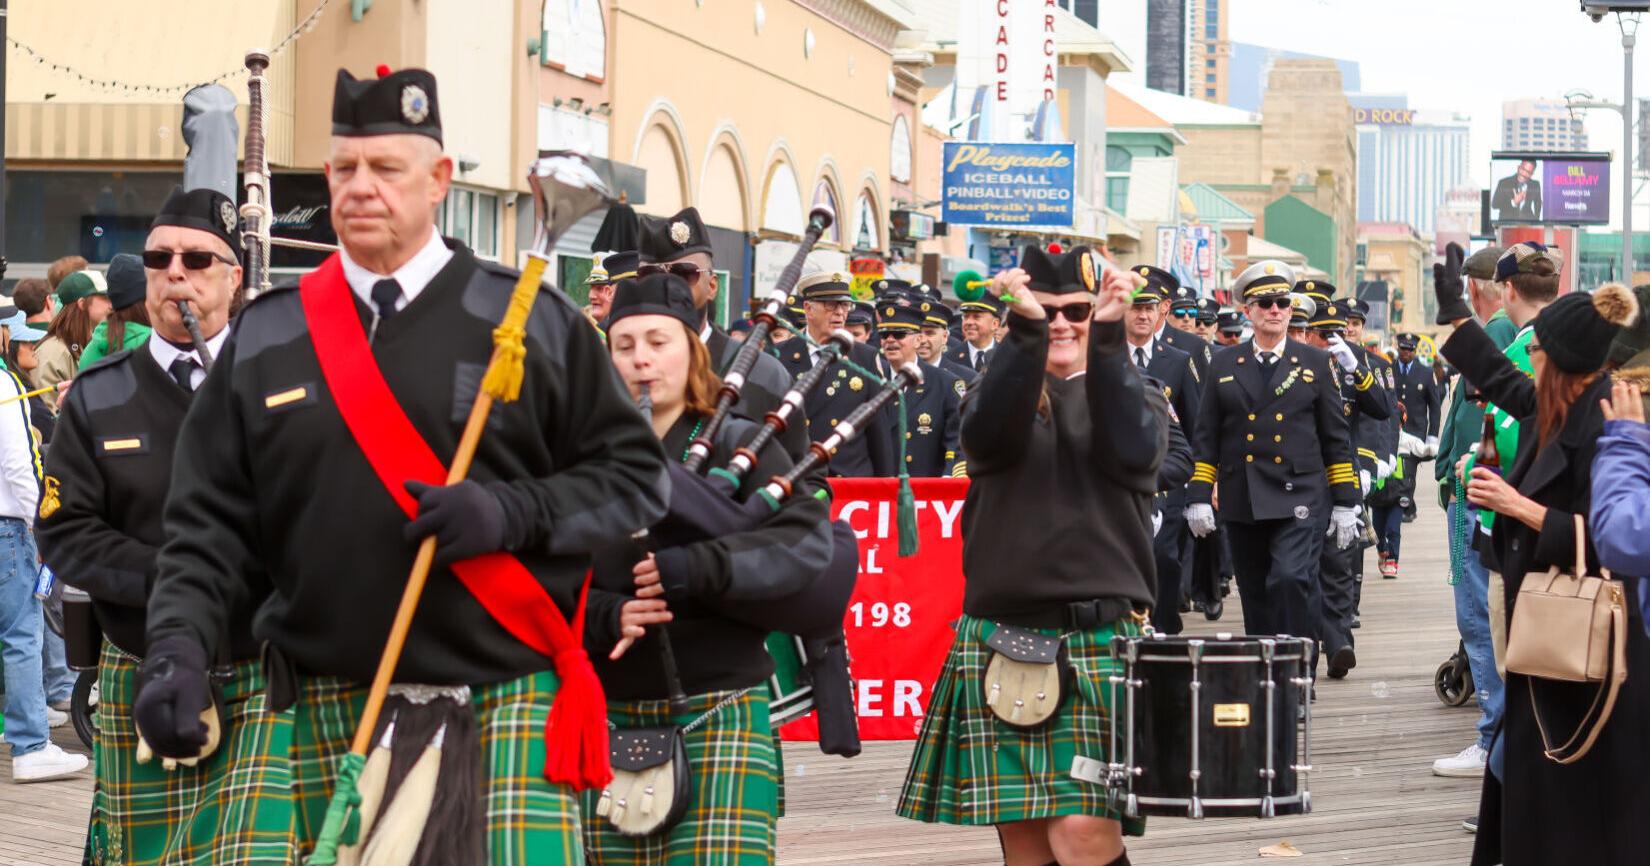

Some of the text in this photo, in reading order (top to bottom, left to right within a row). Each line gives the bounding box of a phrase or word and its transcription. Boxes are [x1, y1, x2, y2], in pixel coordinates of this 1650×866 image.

[1371, 109, 1412, 125] ROCK
[946, 145, 1072, 172] Playcade
[964, 173, 1052, 185] ICEBALL
[947, 187, 1071, 200] PINBALL VIDEO
[850, 602, 912, 628] 198
